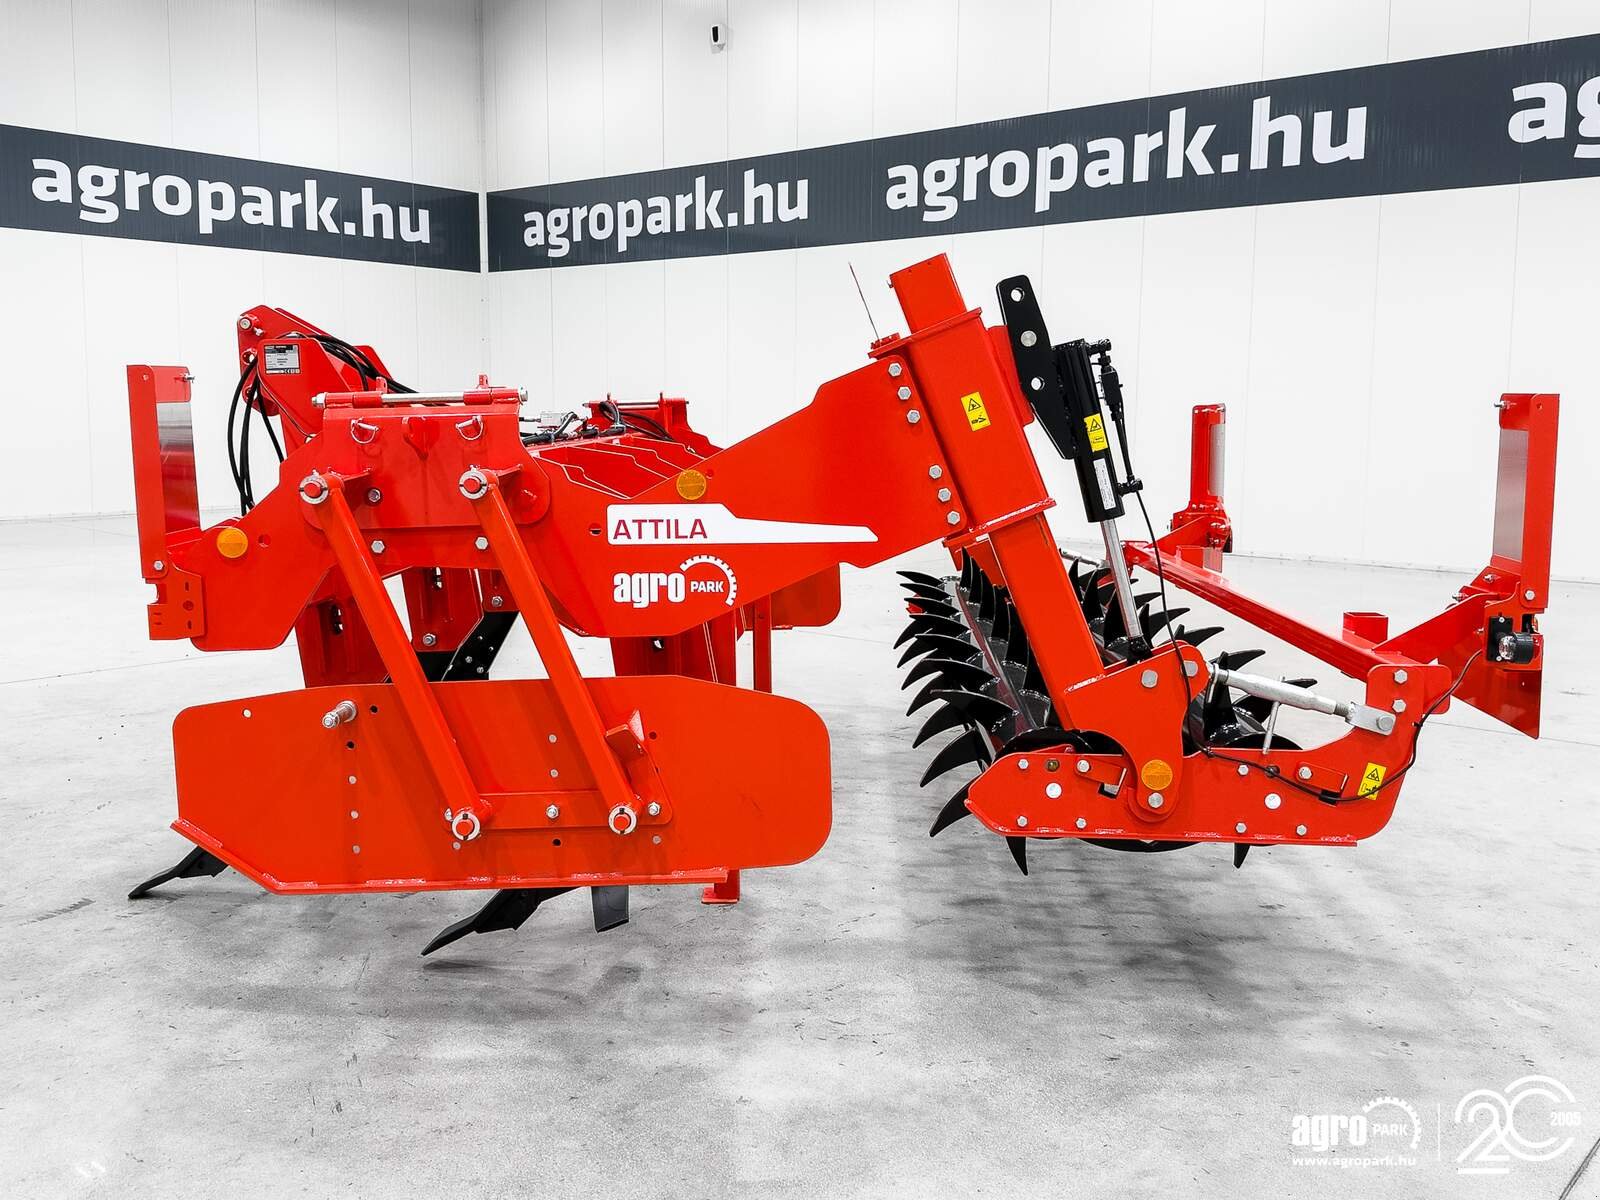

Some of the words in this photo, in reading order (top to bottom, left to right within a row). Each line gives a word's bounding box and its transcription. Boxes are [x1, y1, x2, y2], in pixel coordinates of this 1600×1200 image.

[31, 158, 431, 244] agropark.hu
[885, 95, 1367, 222] agropark.hu
[523, 168, 809, 258] agropark.hu
[613, 518, 708, 540] ATTILA
[613, 572, 686, 609] agro
[690, 580, 724, 593] PARK
